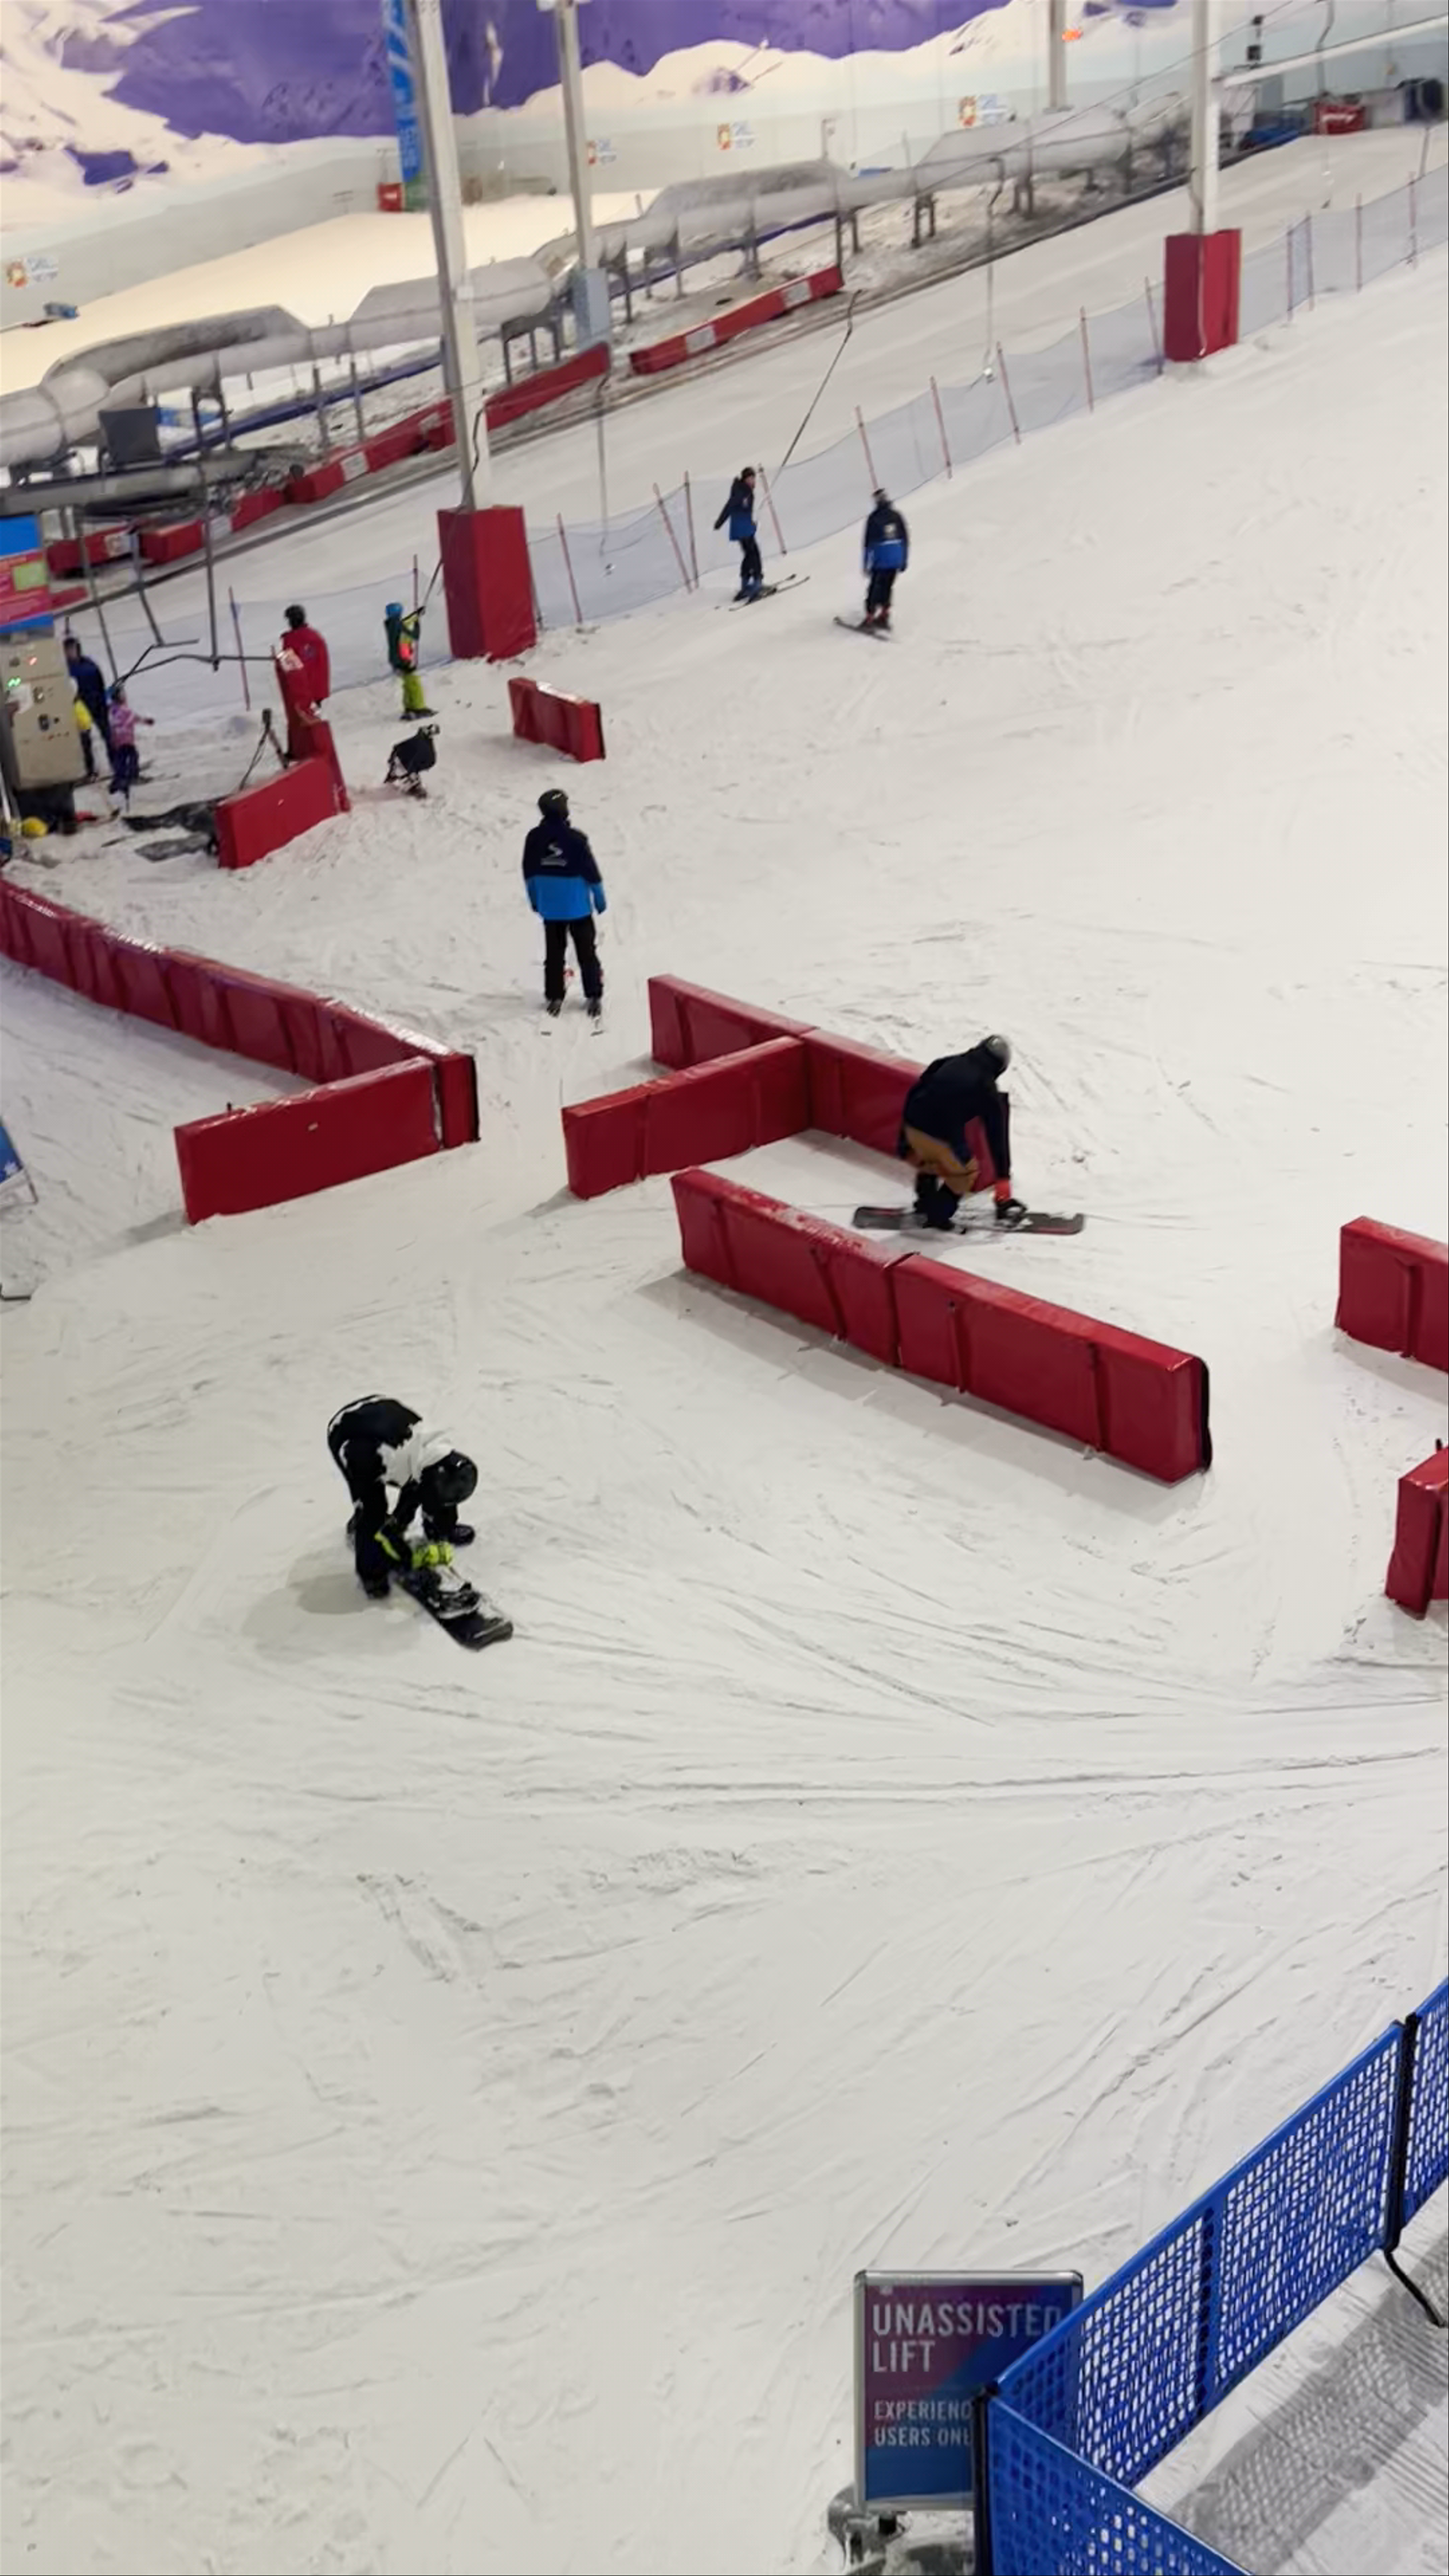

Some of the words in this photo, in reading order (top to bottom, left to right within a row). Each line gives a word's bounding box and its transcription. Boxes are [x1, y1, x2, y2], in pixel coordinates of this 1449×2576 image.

[873, 2303, 1061, 2338] UNASSISTED
[873, 2340, 935, 2372] LIFT
[874, 2401, 972, 2420] EXPERIENC
[874, 2427, 931, 2447] USERS
[938, 2427, 972, 2447] ONL
